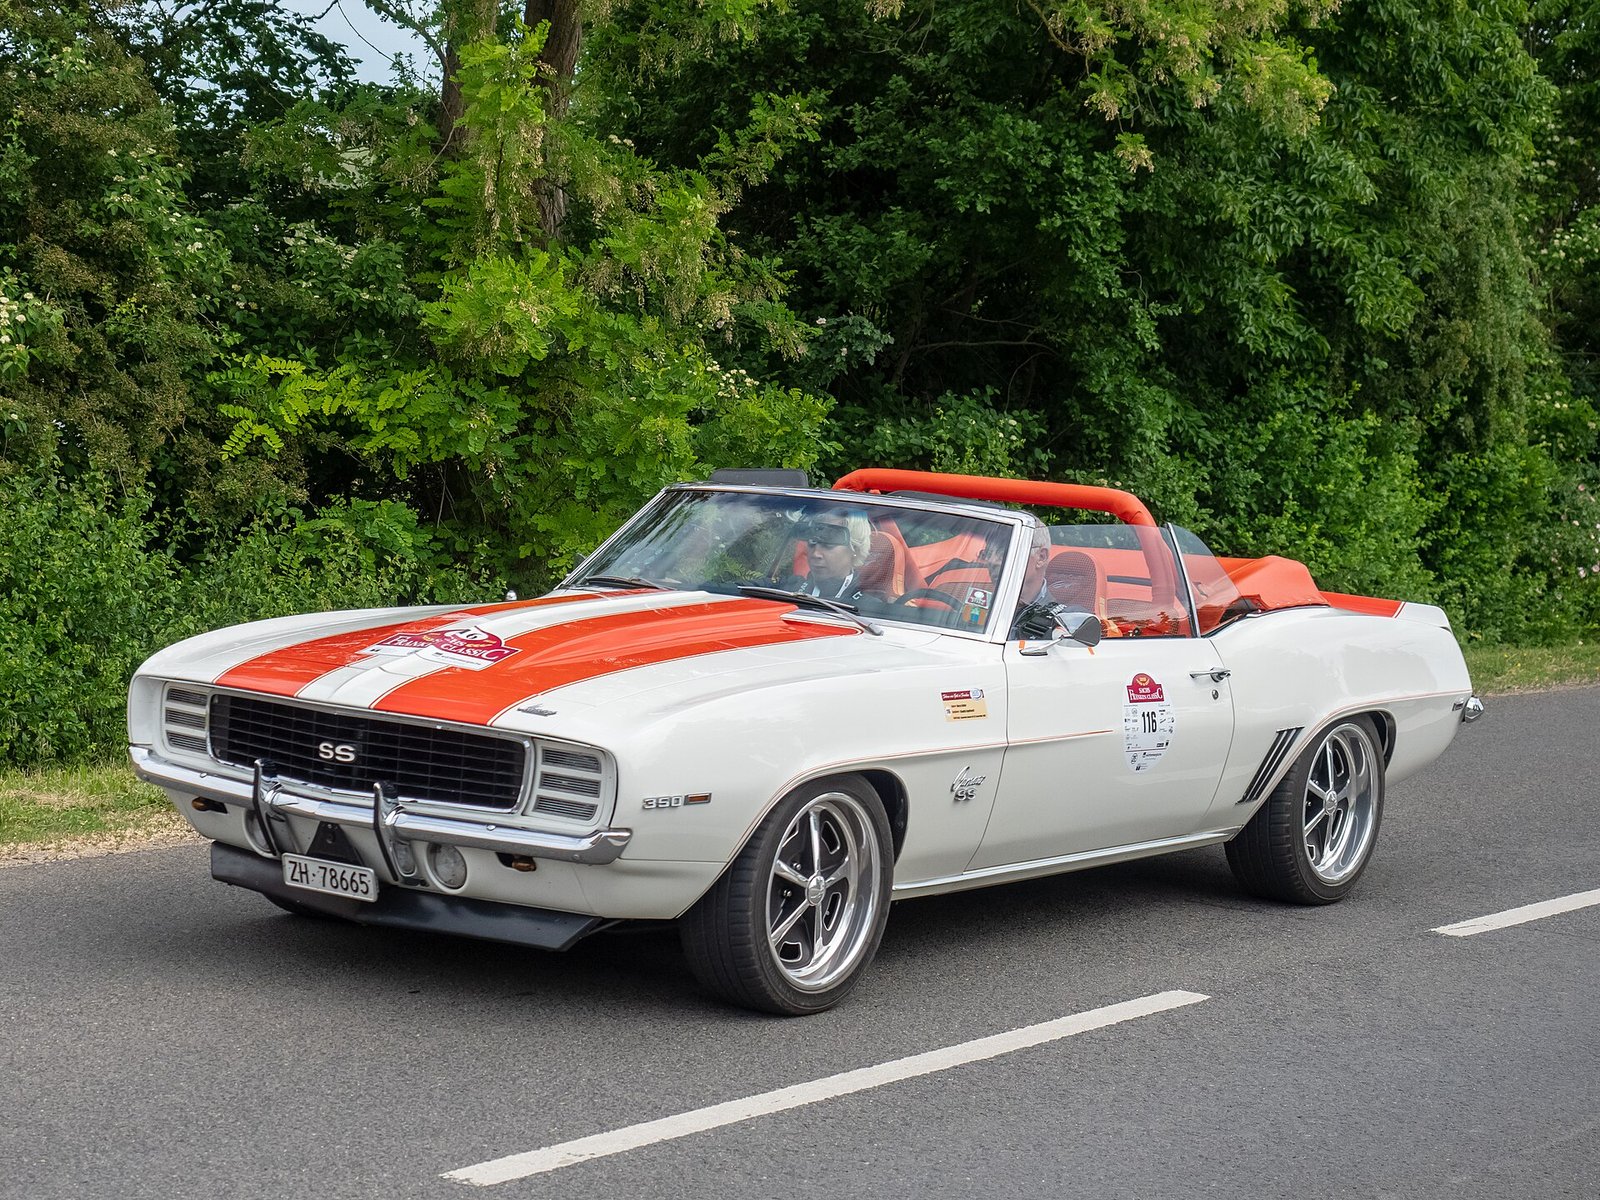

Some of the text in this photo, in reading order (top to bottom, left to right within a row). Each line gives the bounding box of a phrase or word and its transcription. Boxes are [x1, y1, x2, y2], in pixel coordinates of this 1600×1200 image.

[1141, 711, 1157, 733] 116
[318, 742, 356, 762] SS
[642, 796, 683, 810] 350
[954, 788, 977, 802] SS
